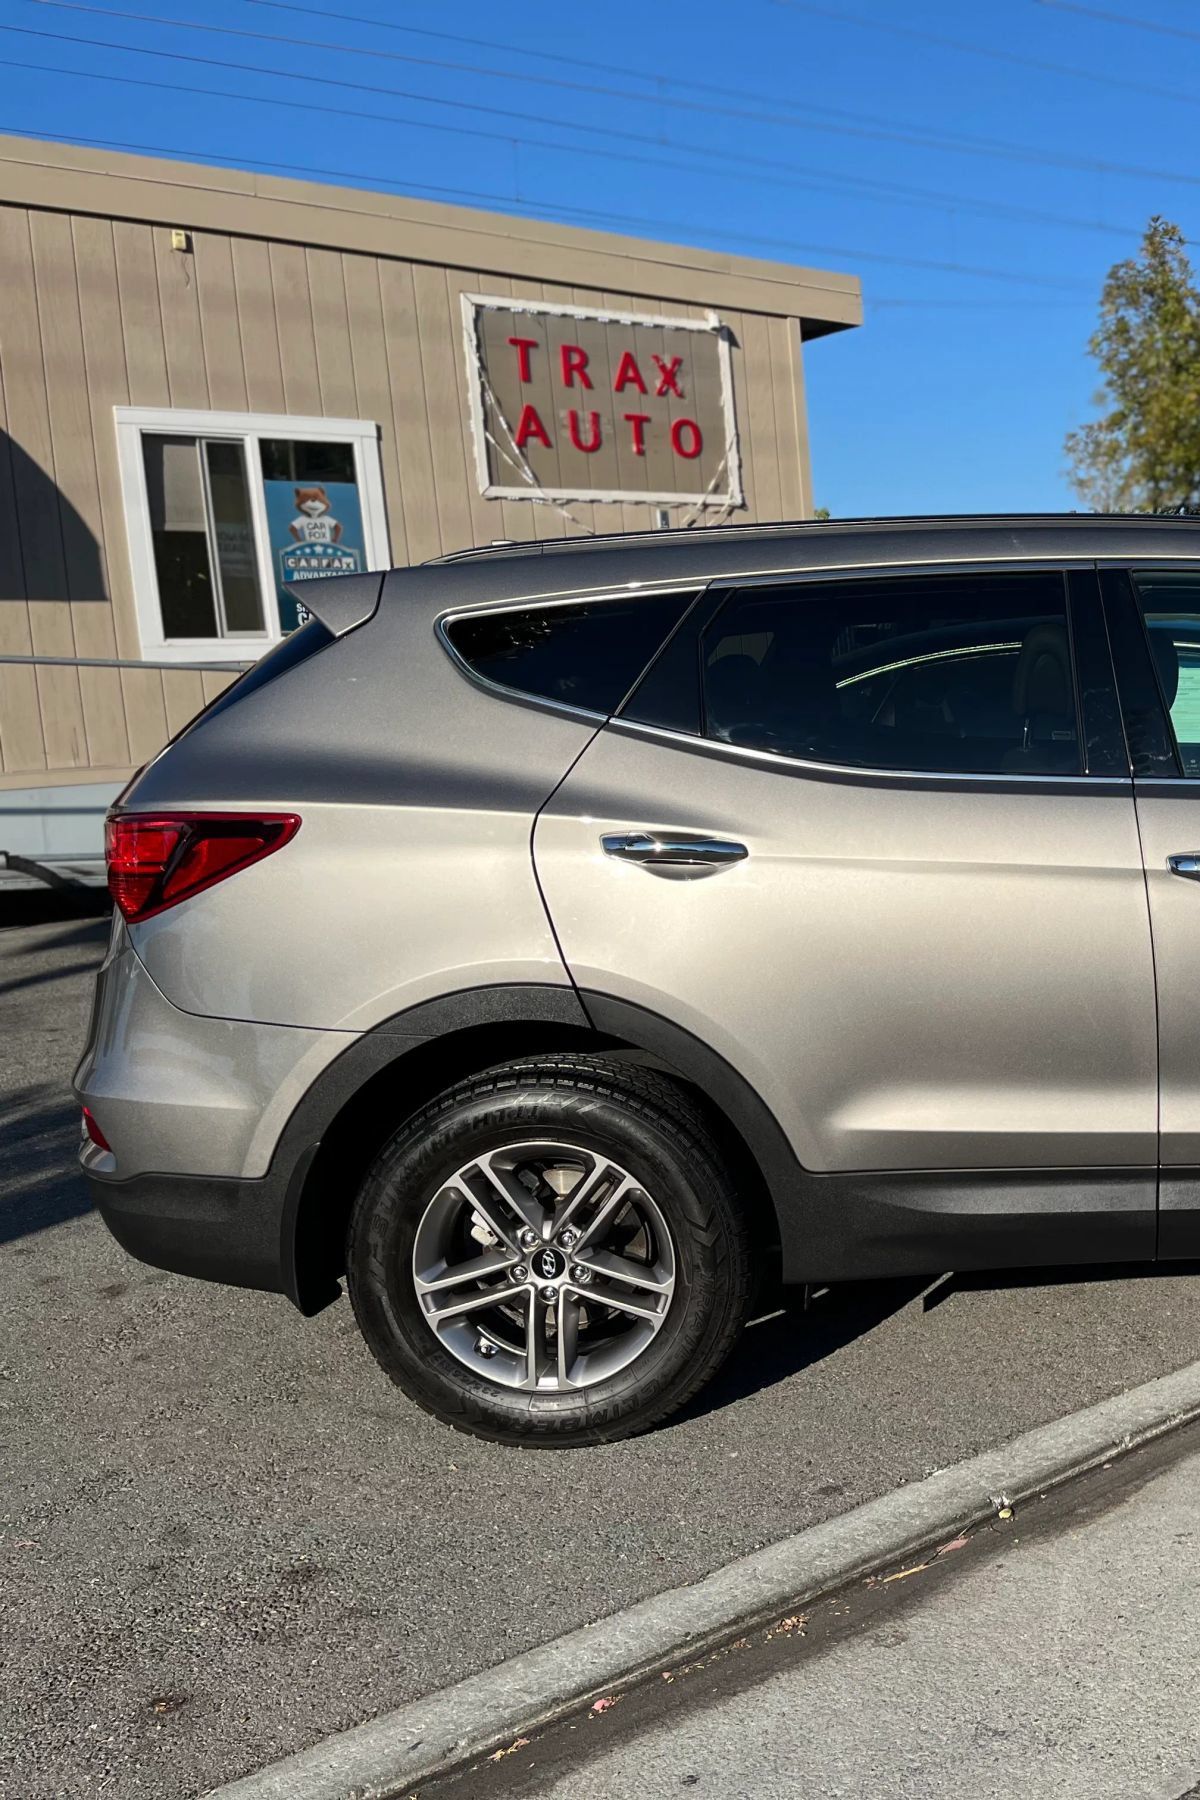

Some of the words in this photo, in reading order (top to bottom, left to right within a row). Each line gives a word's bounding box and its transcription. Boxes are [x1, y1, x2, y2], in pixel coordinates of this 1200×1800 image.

[508, 337, 685, 398] TRAX
[515, 404, 704, 459] AUTO
[307, 522, 326, 530] CAR
[309, 531, 327, 539] FOX
[288, 559, 354, 569] CARFAX
